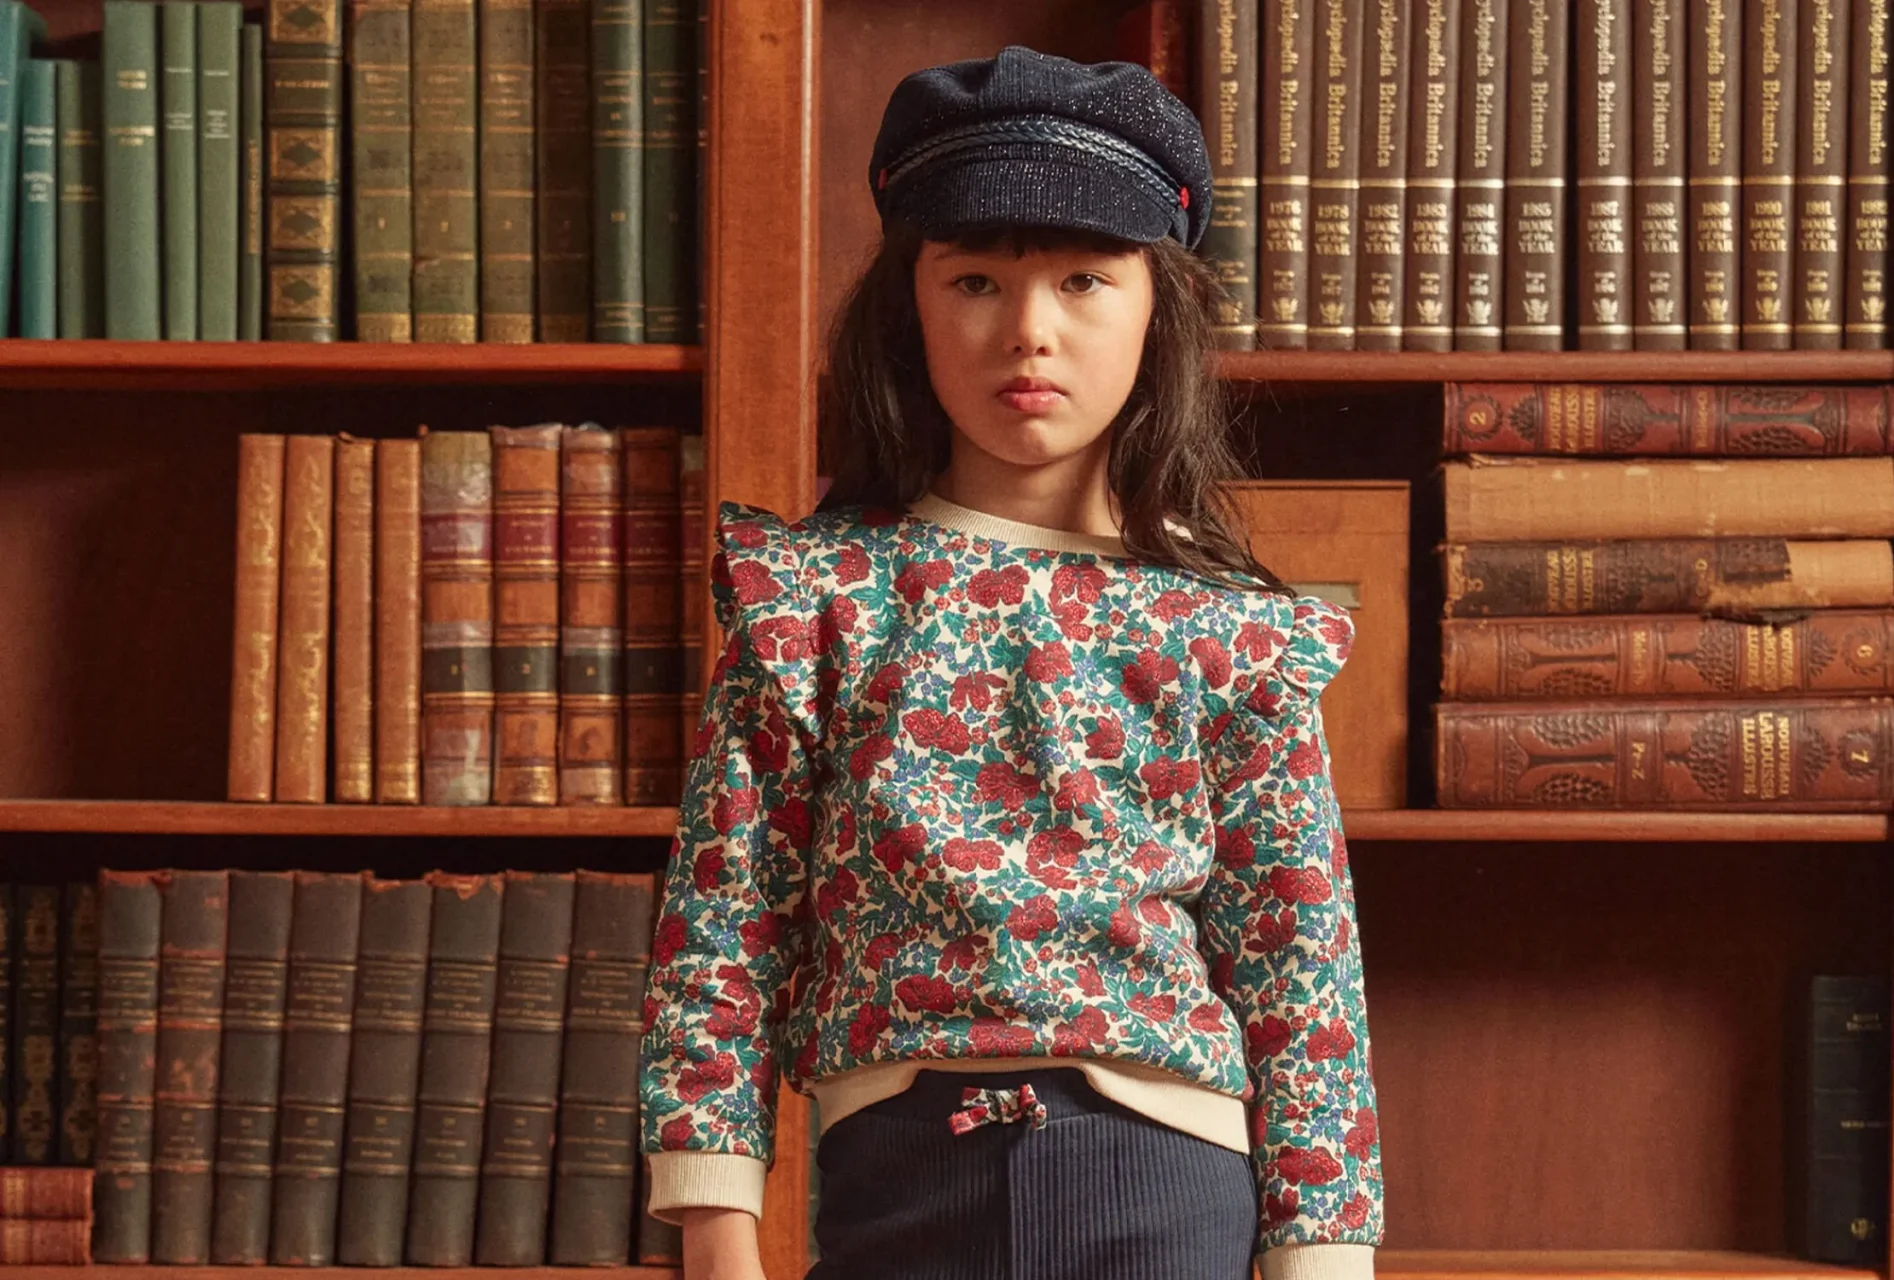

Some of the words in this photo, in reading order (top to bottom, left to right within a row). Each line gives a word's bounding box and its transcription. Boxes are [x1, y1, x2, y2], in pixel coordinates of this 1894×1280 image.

[1220, 80, 1238, 166] Britannica
[1280, 80, 1299, 165] Britannica
[1326, 84, 1347, 168] Britannica
[1377, 83, 1397, 168] Britannica
[1425, 83, 1446, 168] Britannica
[1474, 83, 1495, 168] Britannica
[1530, 82, 1549, 167] Britannica
[1598, 81, 1616, 166] Britannica
[1653, 82, 1671, 167] Britannica
[1707, 80, 1725, 165] Britannica
[1762, 80, 1780, 165] Britannica
[1813, 80, 1832, 165] Britannica
[1869, 80, 1888, 165] Britannica
[1267, 218, 1302, 231] BOOK
[1315, 221, 1350, 234] BOOK
[1364, 220, 1400, 233] BOOK
[1413, 220, 1448, 233] BOOK
[1462, 221, 1498, 234] BOOK
[1518, 220, 1553, 232] BOOK
[1588, 218, 1623, 232] BOOK
[1642, 219, 1678, 232] BOOK
[1698, 218, 1733, 231] BOOK
[1750, 218, 1786, 231] BOOK
[1801, 218, 1837, 231] BOOK
[1856, 218, 1888, 230] BOOK
[1267, 239, 1303, 252] YEAR
[1315, 243, 1350, 255] YEAR
[1364, 242, 1401, 254] YEAR
[1413, 242, 1449, 254] YEAR
[1462, 242, 1499, 255] YEAR
[1518, 242, 1554, 253] YEAR
[1588, 240, 1624, 253] YEAR
[1643, 240, 1679, 253] YEAR
[1698, 239, 1733, 252] YEAR
[1751, 239, 1787, 252] YEAR
[1801, 239, 1837, 252] YEAR
[1469, 411, 1486, 425] 2
[1857, 645, 1873, 658] 6
[1631, 742, 1645, 780] Pr-Z
[1758, 713, 1775, 799] LAROUSSE
[1777, 717, 1790, 794] NOUVEAU
[1851, 749, 1869, 763] 7
